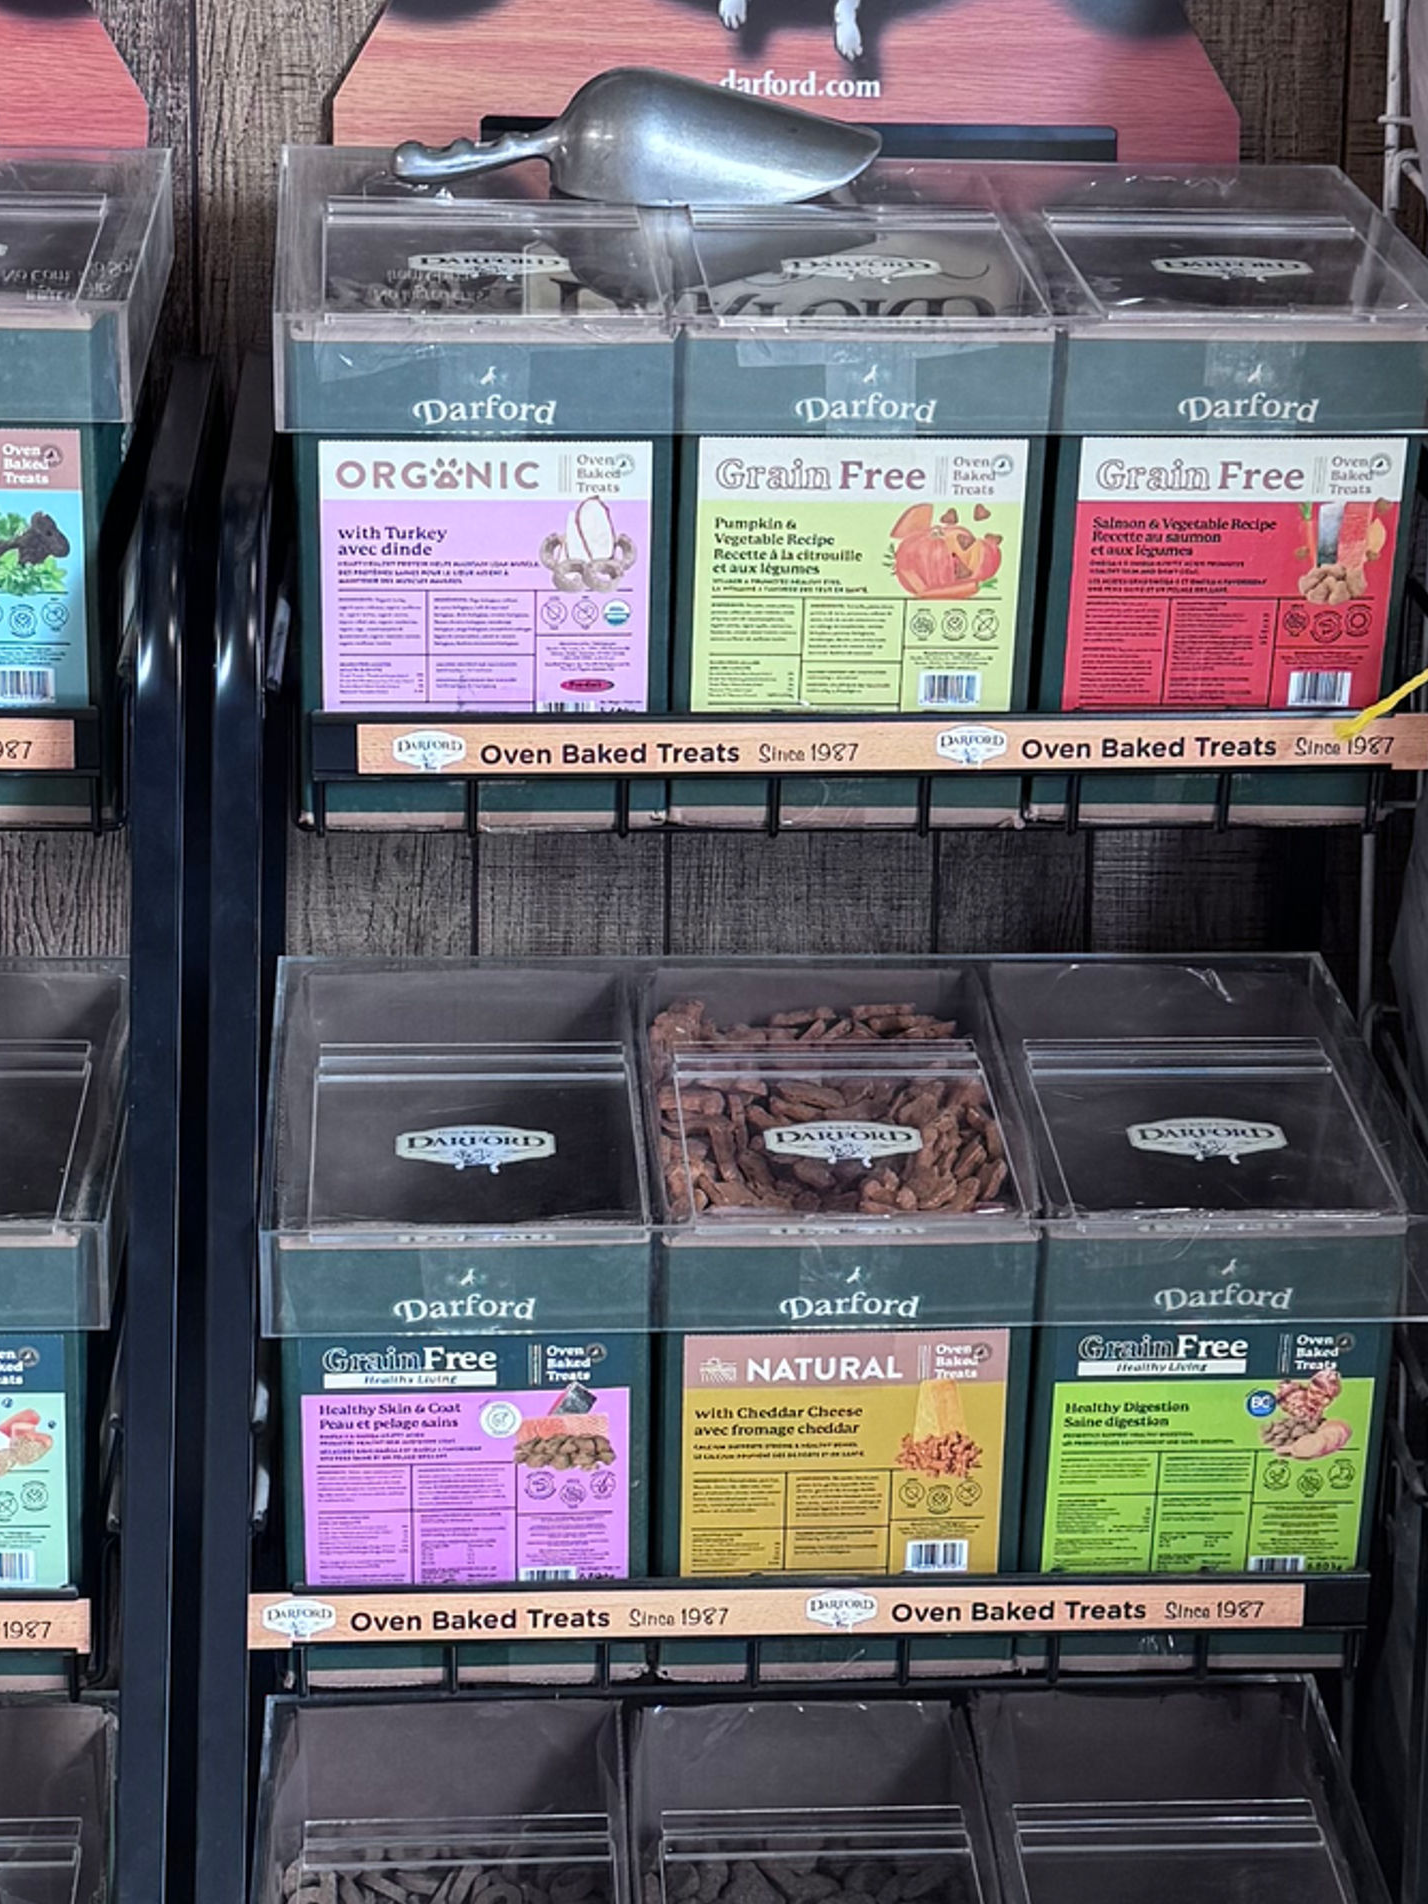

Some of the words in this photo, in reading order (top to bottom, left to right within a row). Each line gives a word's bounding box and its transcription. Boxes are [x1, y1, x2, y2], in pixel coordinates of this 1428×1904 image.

[716, 458, 831, 491] Grain
[838, 461, 926, 491] Free
[1093, 517, 1145, 532] Salmon
[1162, 517, 1228, 534] Vegetable
[1231, 518, 1276, 534] Recipe
[338, 526, 381, 541] with
[385, 526, 447, 544] Turkey
[338, 543, 371, 556] avec
[374, 542, 433, 556] dinde
[746, 1356, 902, 1382] NATURAL
[319, 1403, 376, 1417] Healthy
[379, 1402, 412, 1416] Skin
[429, 1402, 461, 1415] Coat
[696, 1407, 733, 1419] with
[737, 1407, 803, 1419] Cheddar
[807, 1406, 863, 1418] Cheese
